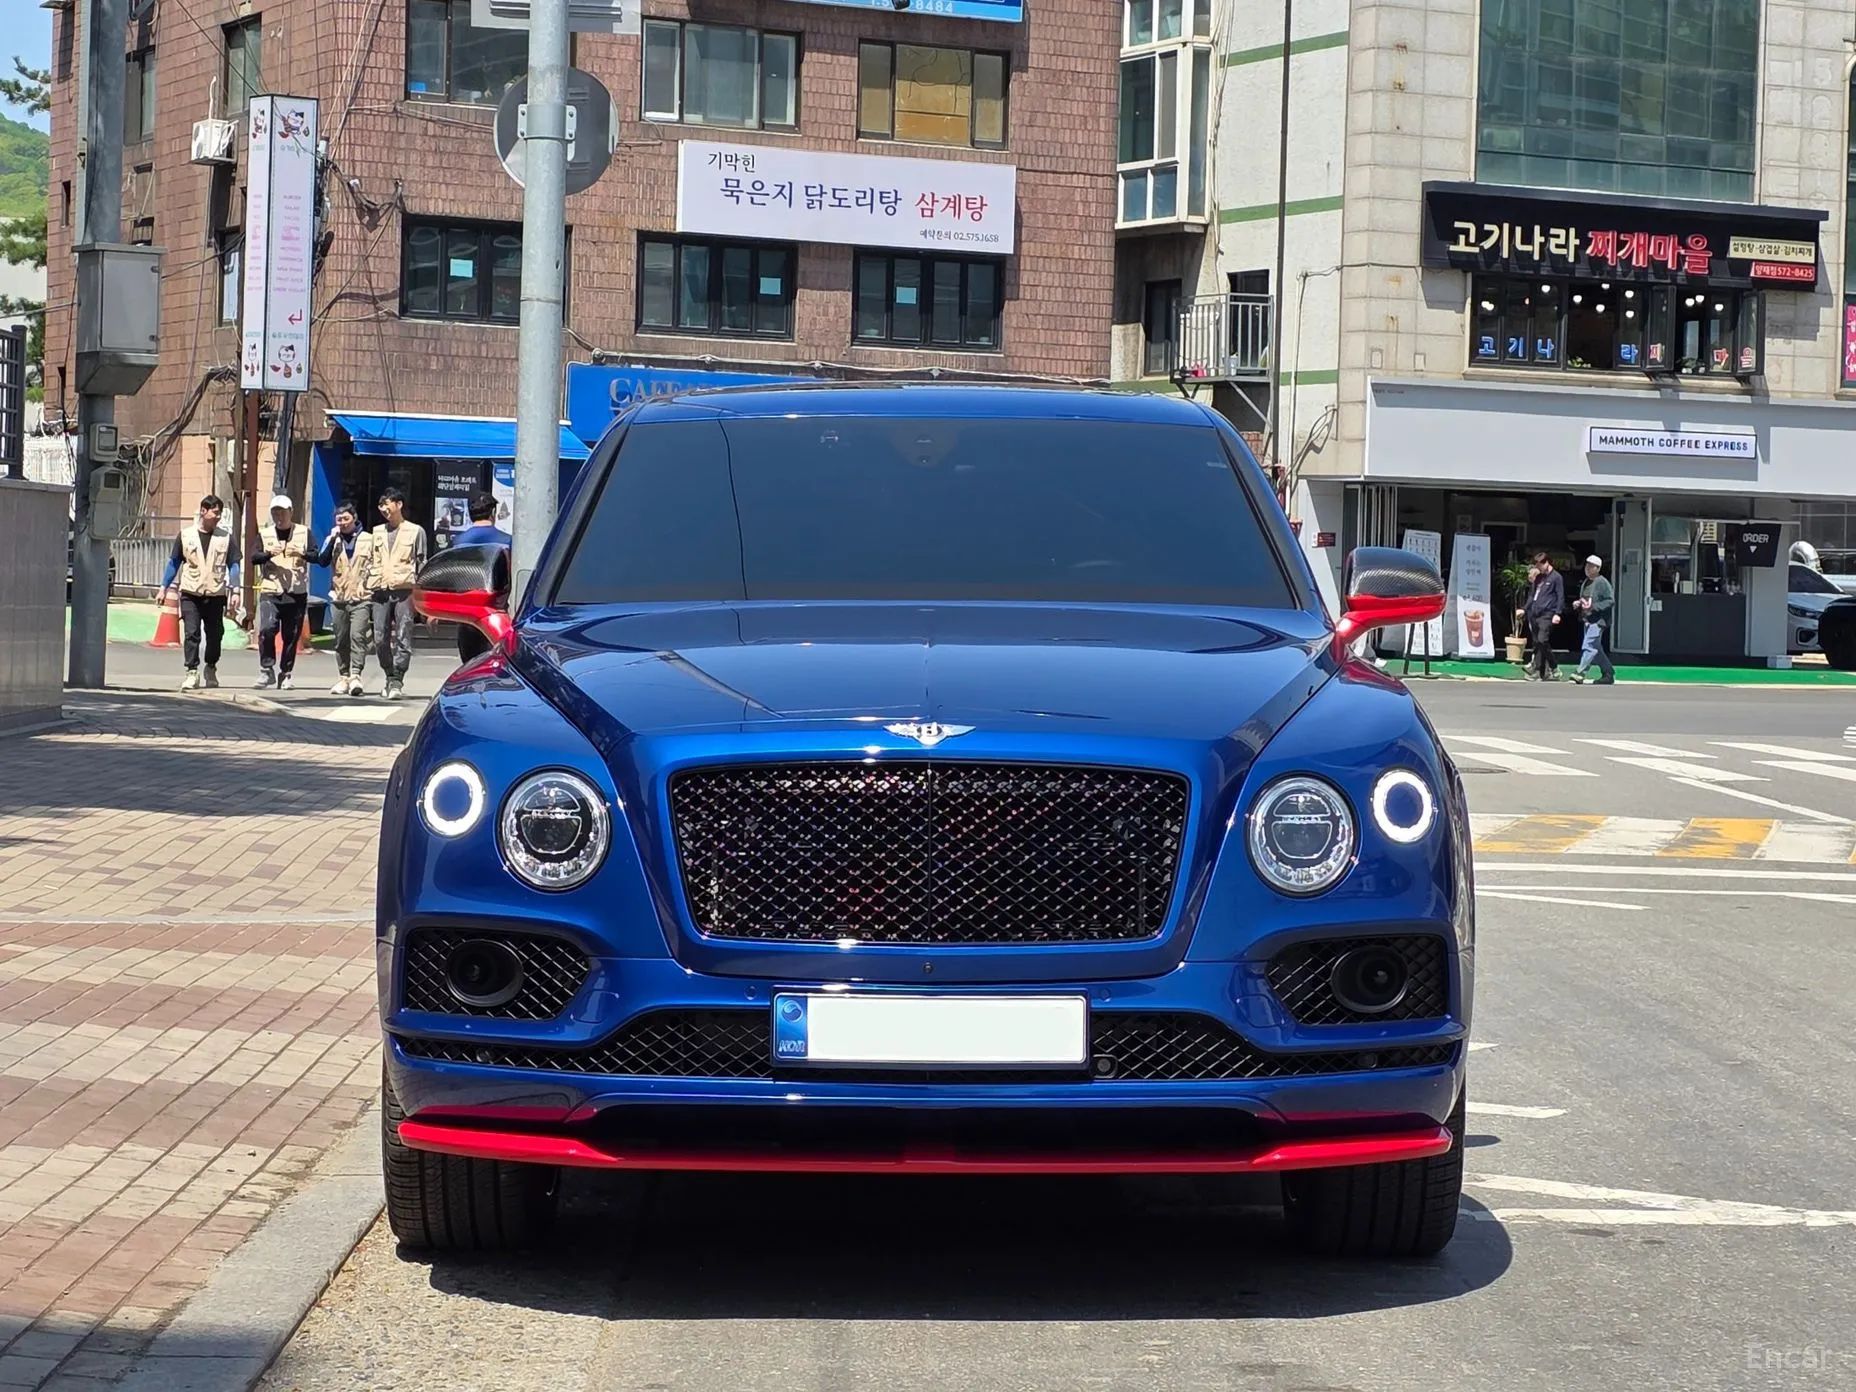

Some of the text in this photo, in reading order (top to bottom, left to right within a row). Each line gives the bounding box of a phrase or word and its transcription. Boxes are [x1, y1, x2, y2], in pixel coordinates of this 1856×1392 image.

[708, 151, 756, 173] 기막힌
[720, 177, 988, 222] 묵은지 닭도리탕 삼계탕
[1448, 220, 1713, 274] 고기나라 찌개마을
[1599, 435, 1748, 451] MAMMOTH COFFEE EXPRESS
[1742, 532, 1769, 543] ORDER
